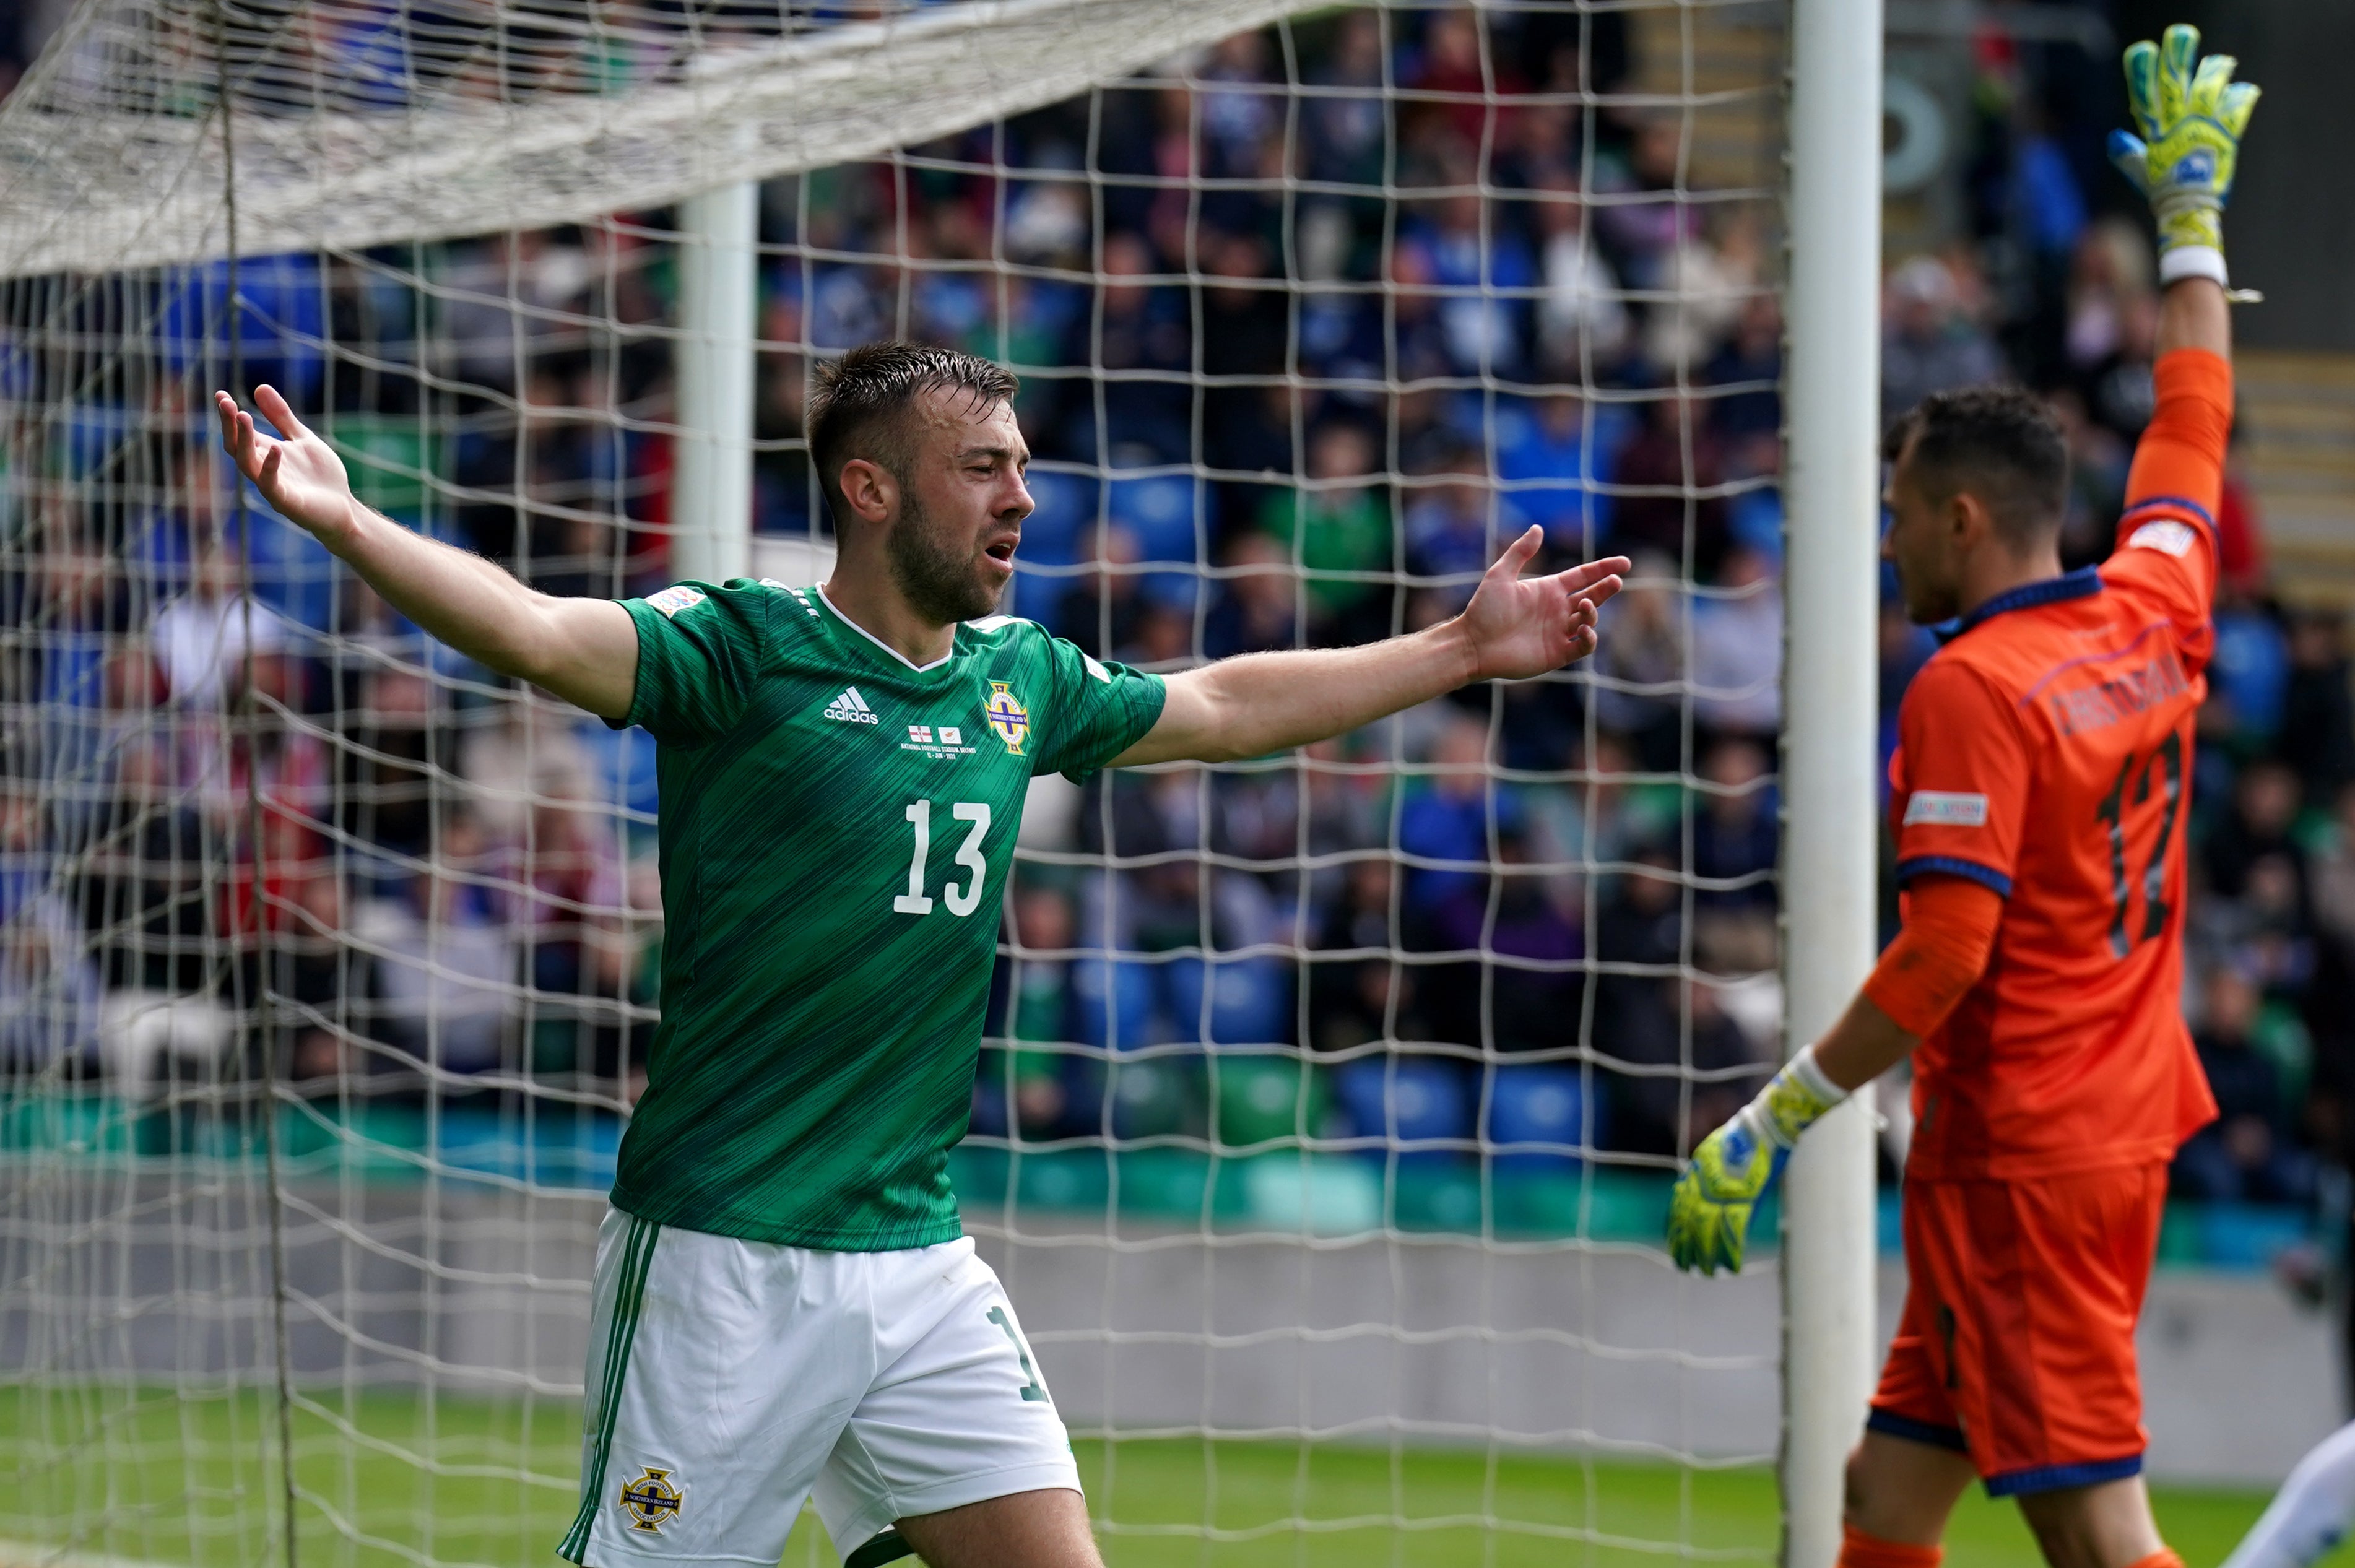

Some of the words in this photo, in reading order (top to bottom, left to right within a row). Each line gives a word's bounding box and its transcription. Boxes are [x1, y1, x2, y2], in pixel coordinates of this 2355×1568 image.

[823, 708, 879, 725] adidas
[901, 743, 921, 751] NATIONAL
[893, 799, 991, 917] 13
[635, 1482, 648, 1491] IRISH
[649, 1481, 670, 1496] FOOTBALL
[630, 1494, 654, 1504] NORTHERN
[633, 1507, 666, 1521] ASSOCIATION
